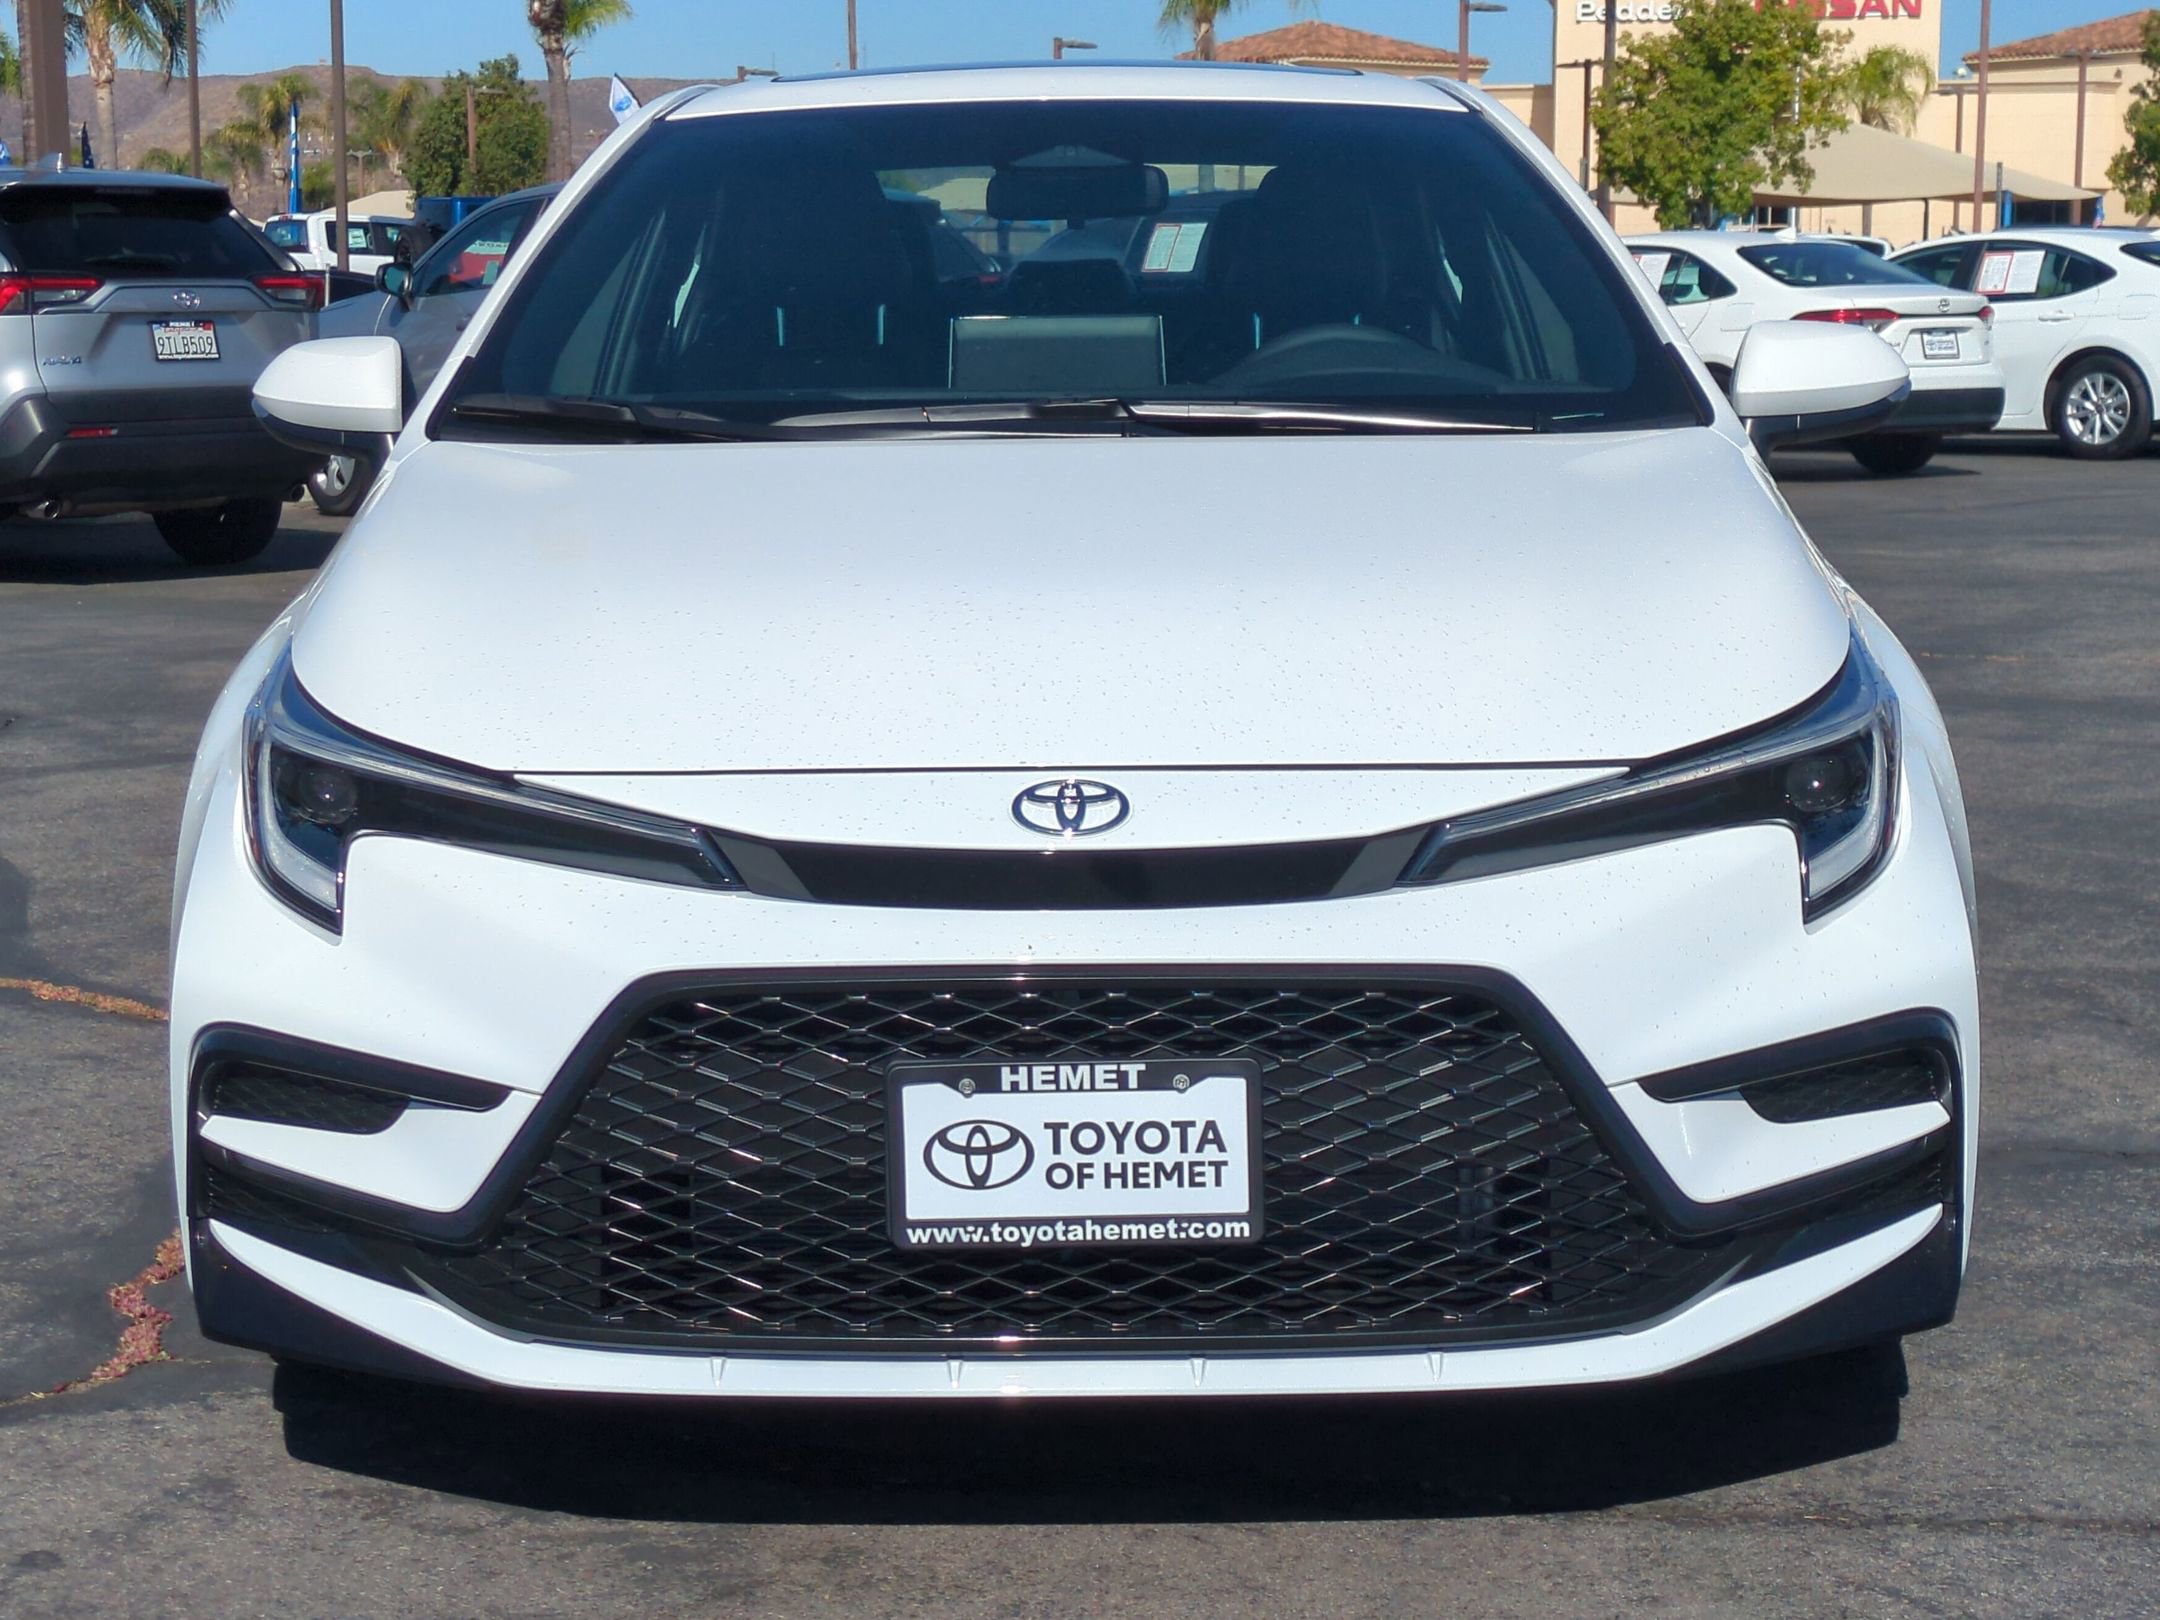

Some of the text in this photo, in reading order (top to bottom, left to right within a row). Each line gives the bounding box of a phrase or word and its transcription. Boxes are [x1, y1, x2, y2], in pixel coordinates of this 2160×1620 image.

[158, 336, 214, 355] 9TLB509
[1000, 1063, 1146, 1091] HEMET
[1043, 1119, 1228, 1156] TOYOTA
[1045, 1160, 1229, 1190] OF HEMET
[906, 1219, 1250, 1247] www.toyotahemet.com
